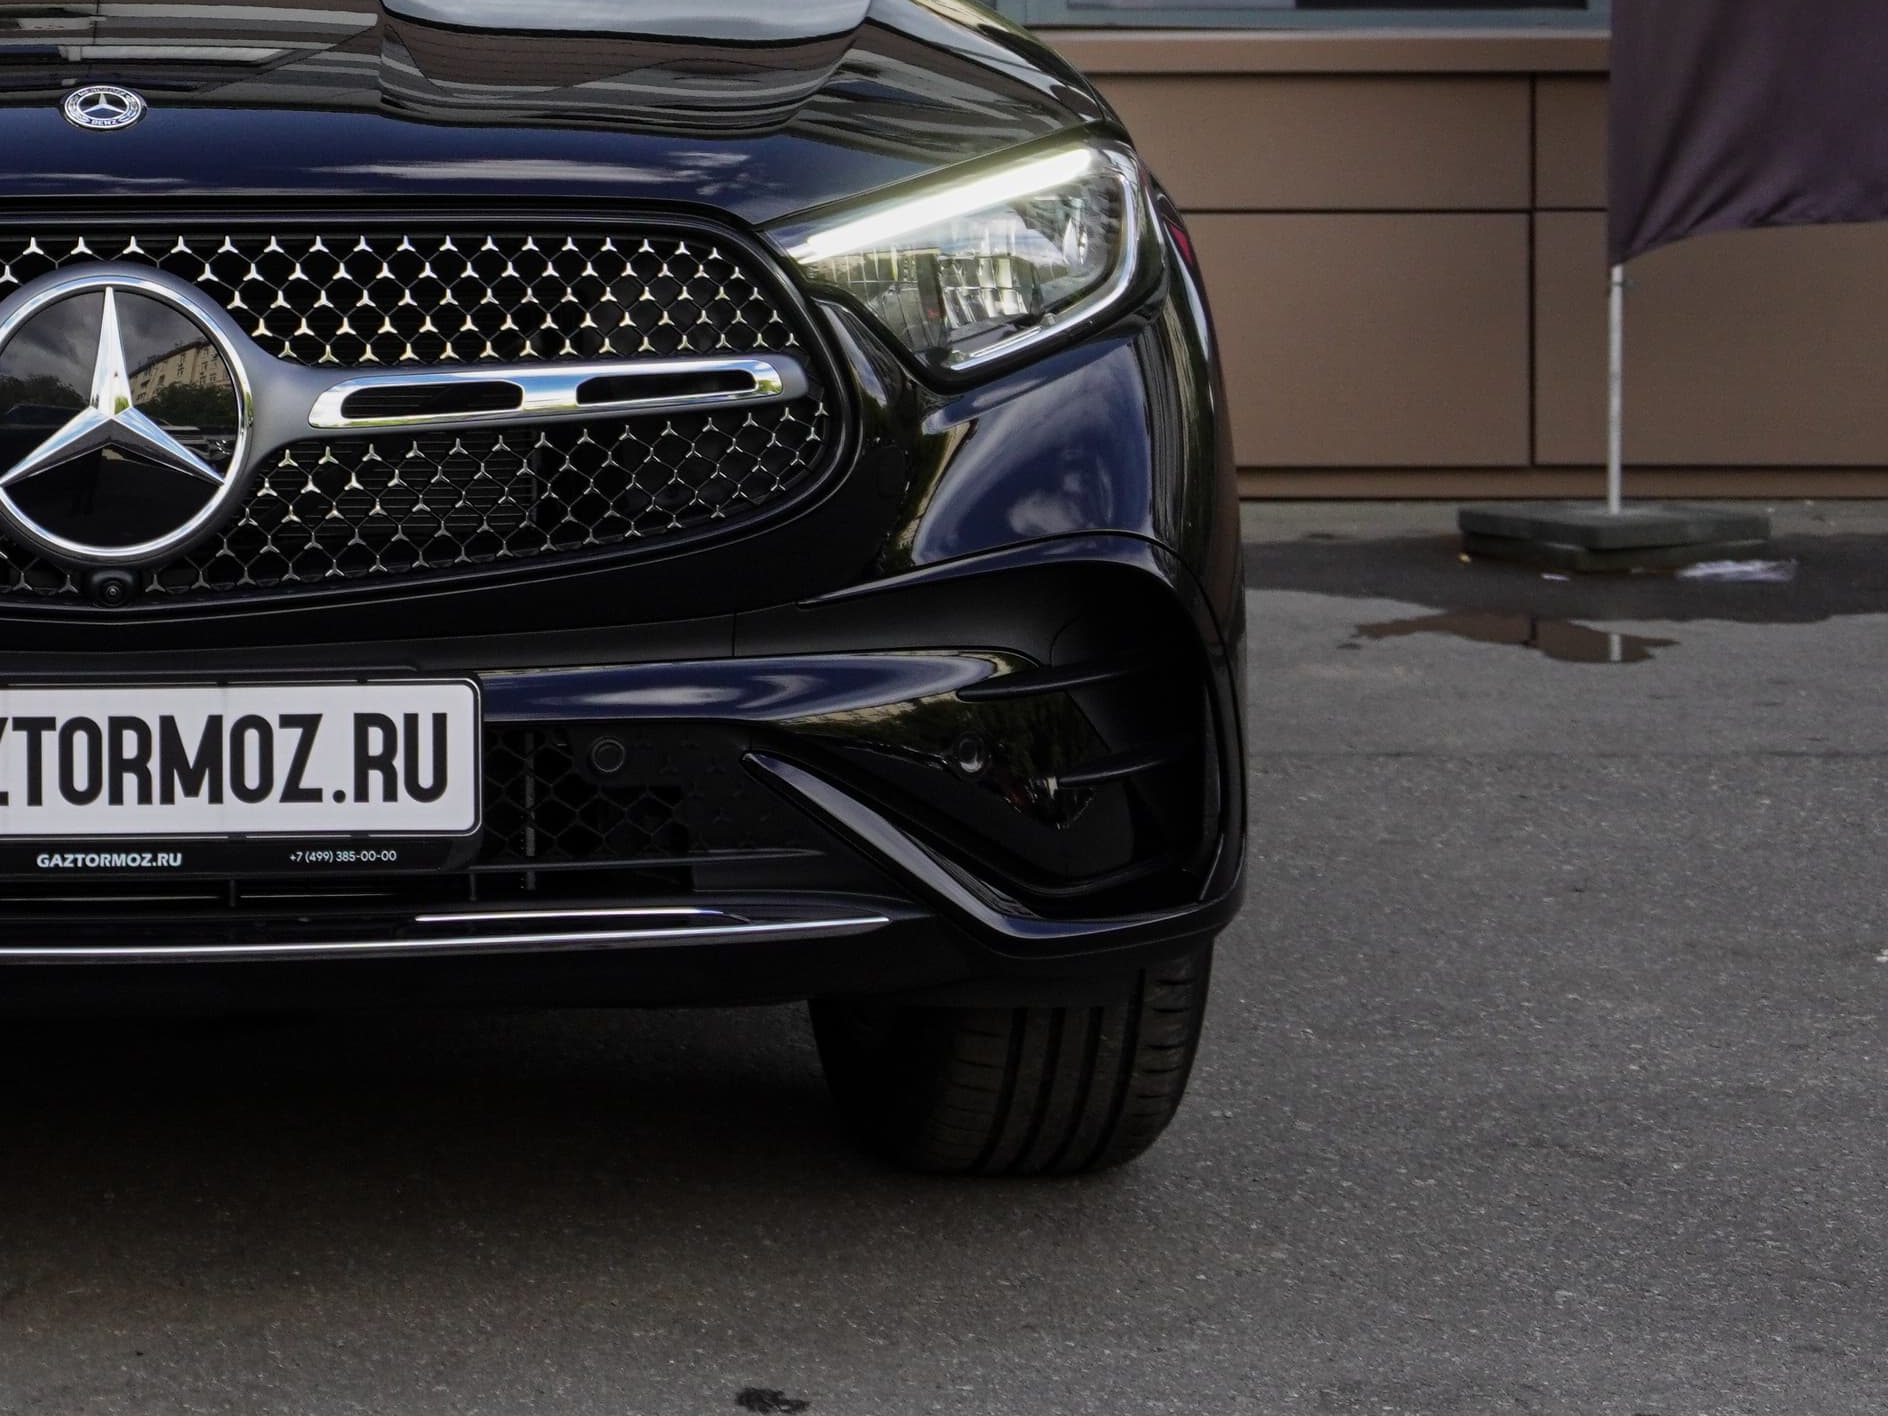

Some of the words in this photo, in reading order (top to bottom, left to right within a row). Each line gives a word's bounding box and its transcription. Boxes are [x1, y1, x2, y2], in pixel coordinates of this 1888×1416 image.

[36, 852, 182, 868] GAZTORMOZ.RU
[289, 850, 304, 863] +7
[305, 850, 333, 864] (499)
[335, 850, 397, 862] 385-00-00
